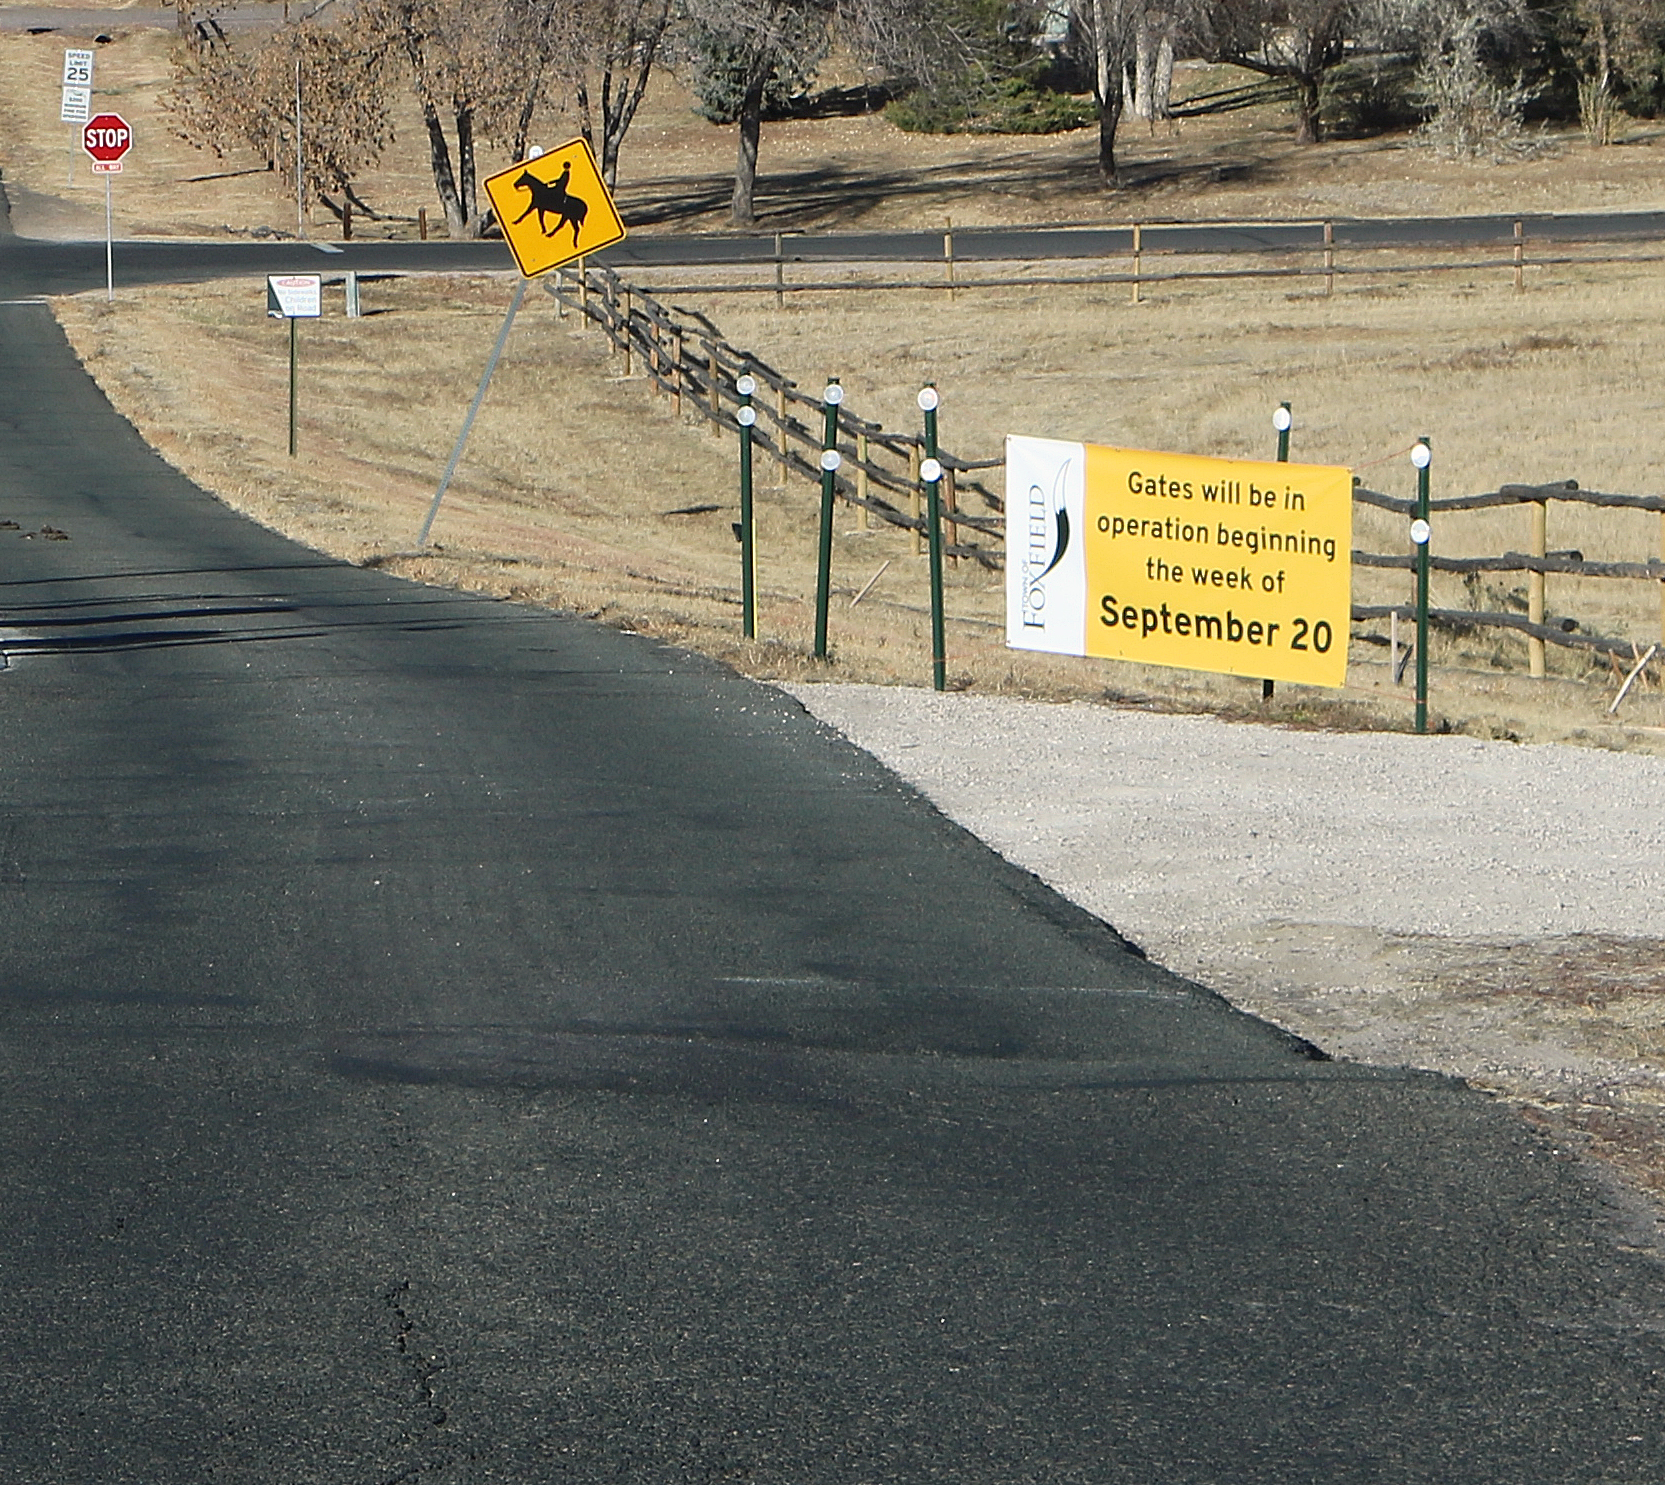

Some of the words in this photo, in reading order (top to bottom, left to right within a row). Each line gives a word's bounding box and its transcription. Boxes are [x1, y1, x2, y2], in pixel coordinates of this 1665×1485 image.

[67, 67, 89, 81] 25
[86, 128, 128, 148] STOP
[297, 304, 317, 312] Road
[1128, 471, 1193, 500] Gates
[1202, 480, 1240, 504] will
[1249, 484, 1276, 508] be
[1284, 486, 1305, 511] in
[1097, 515, 1208, 543] operation
[1217, 523, 1336, 562] beginning
[1022, 484, 1047, 634] FOXFIELD
[1146, 557, 1183, 583] the
[1192, 567, 1252, 590] week
[1262, 570, 1285, 593] of
[1100, 595, 1280, 646] September
[1291, 617, 1333, 653] 20
